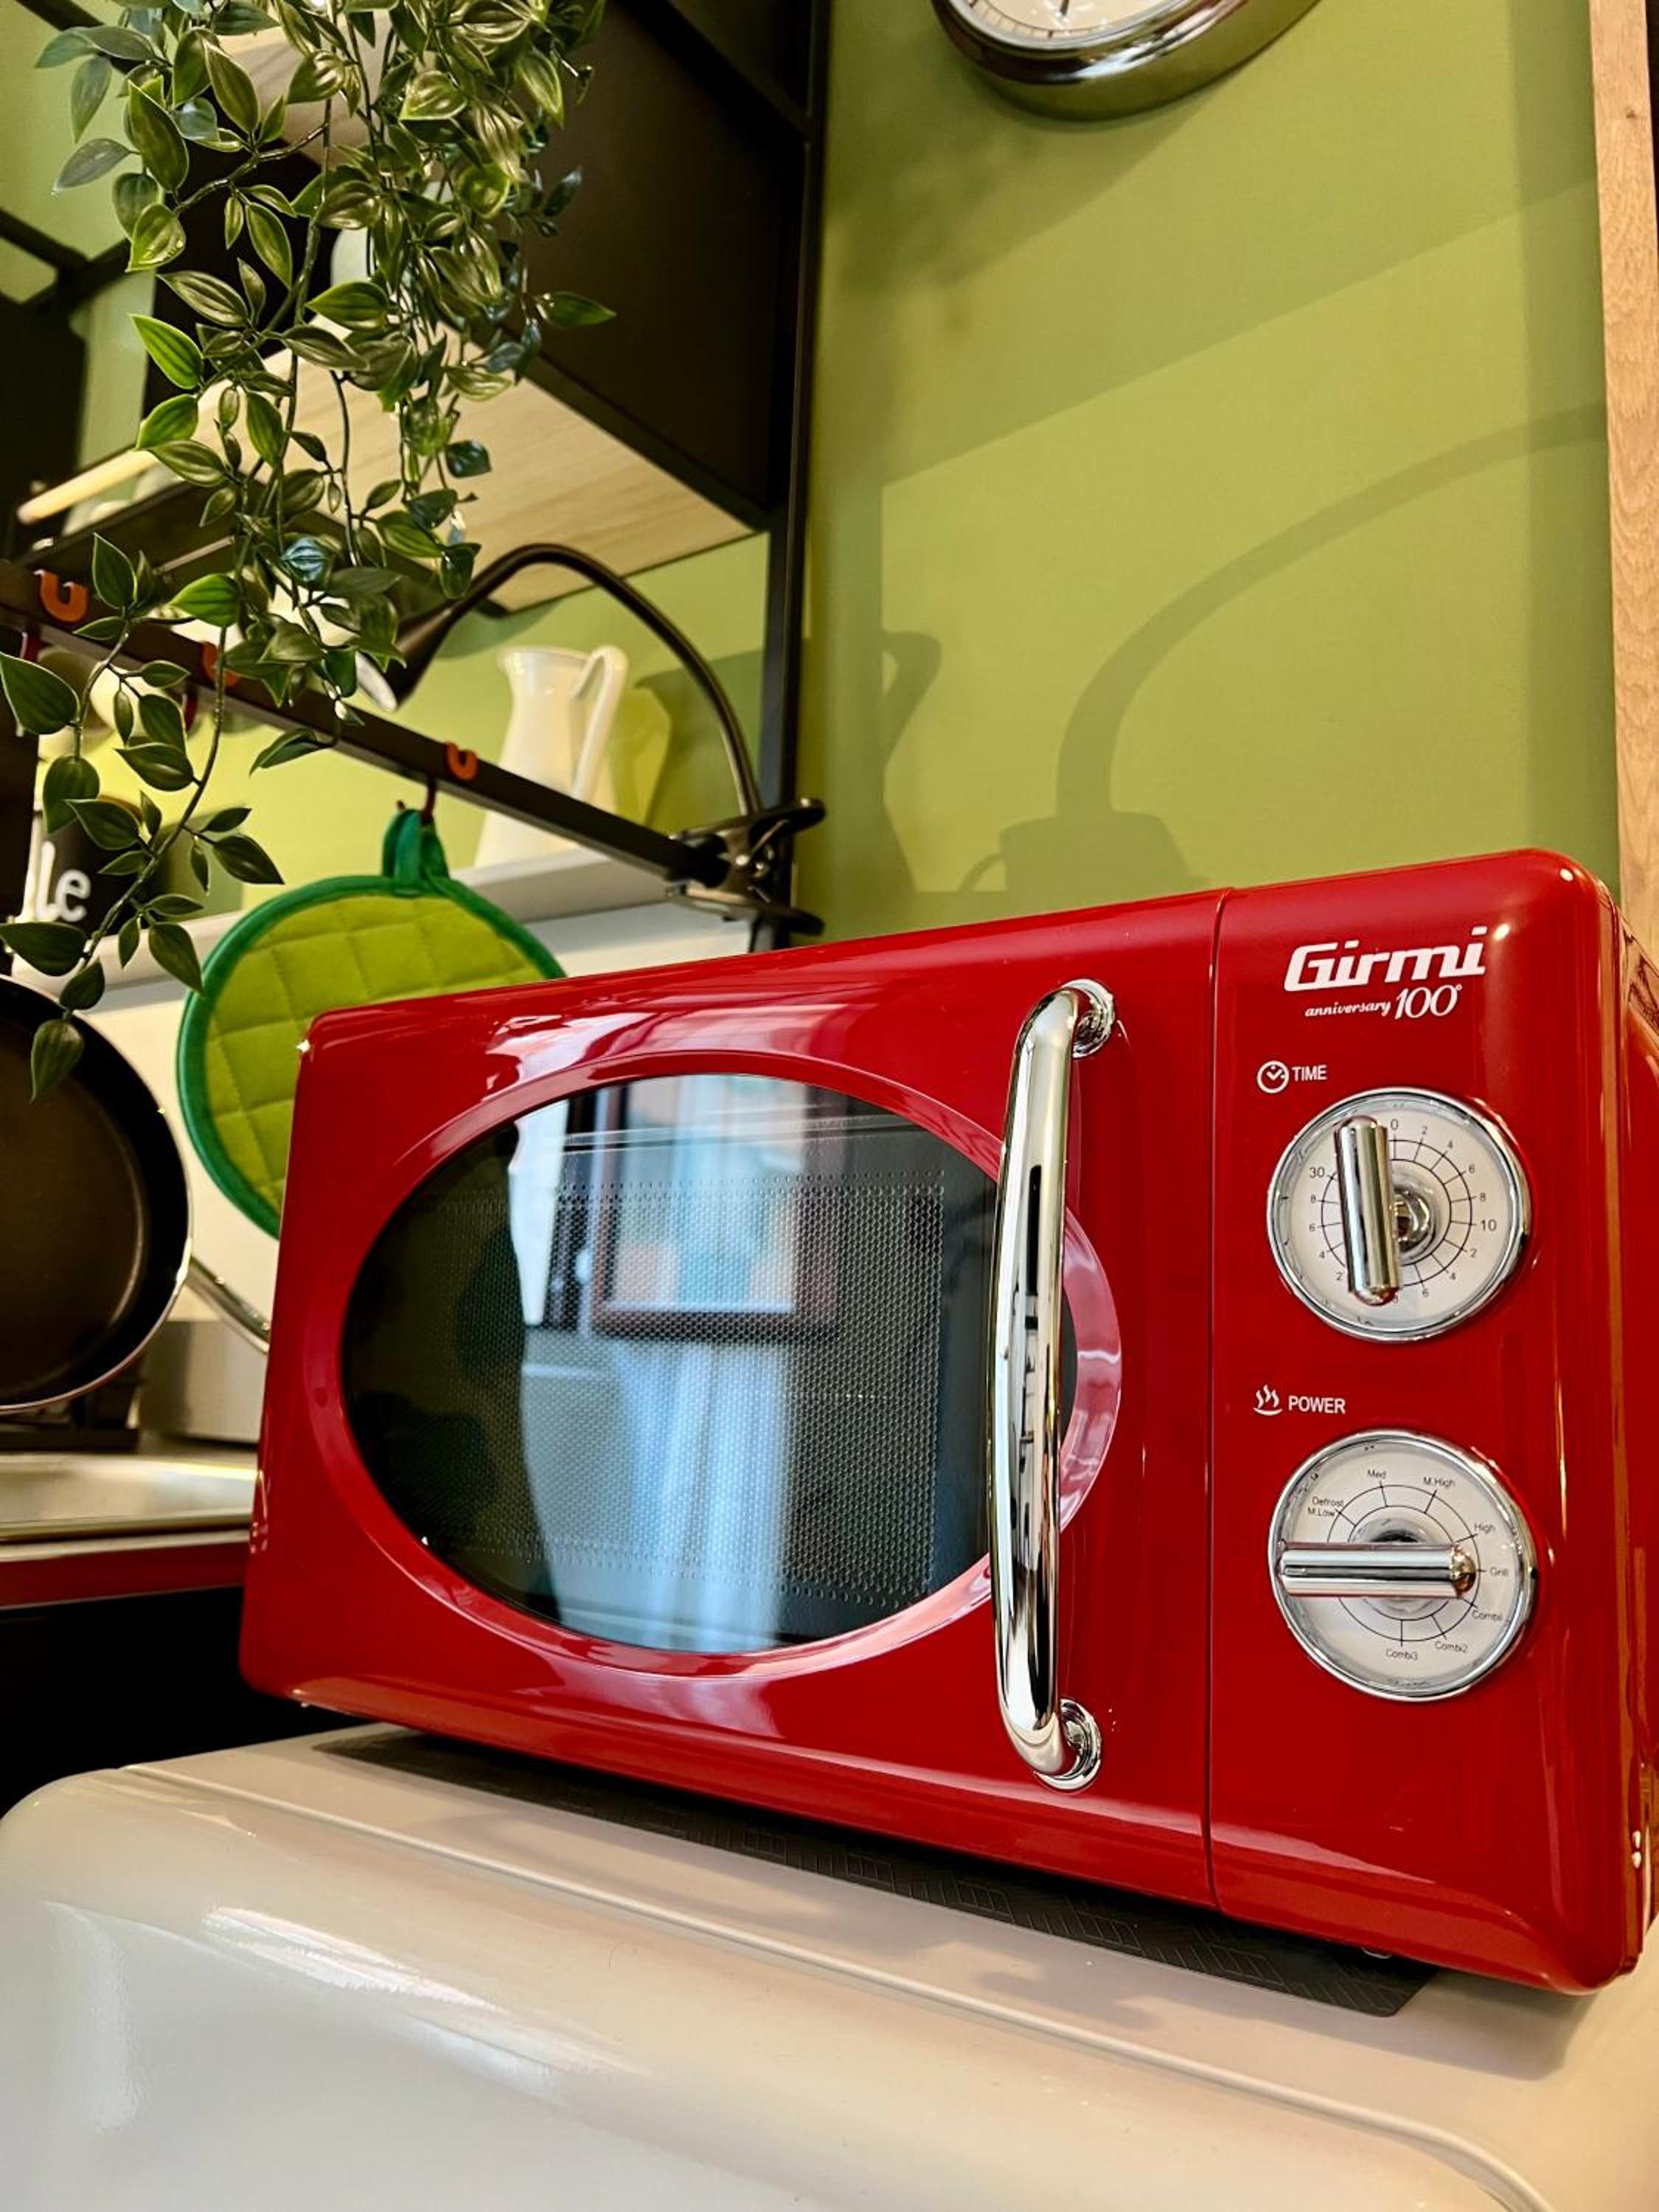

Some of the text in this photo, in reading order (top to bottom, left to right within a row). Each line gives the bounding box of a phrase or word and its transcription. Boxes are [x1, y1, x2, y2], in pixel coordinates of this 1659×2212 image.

[1284, 925, 1488, 992] Girmi
[1304, 1001, 1391, 1018] anniversary
[1291, 1064, 1327, 1082] TIME
[1390, 1119, 1399, 1130] 0
[1421, 1125, 1428, 1135] 2
[1447, 1140, 1454, 1150] 4
[1309, 1166, 1325, 1179] 30
[1468, 1164, 1475, 1174] 6
[1479, 1192, 1486, 1202] 8
[1481, 1219, 1498, 1231] 10
[1335, 1271, 1343, 1281] 2
[1287, 1395, 1346, 1415] POWER
[1367, 1469, 1387, 1480] Med
[1312, 1495, 1344, 1508] Defrost
[1474, 1522, 1496, 1534] High
